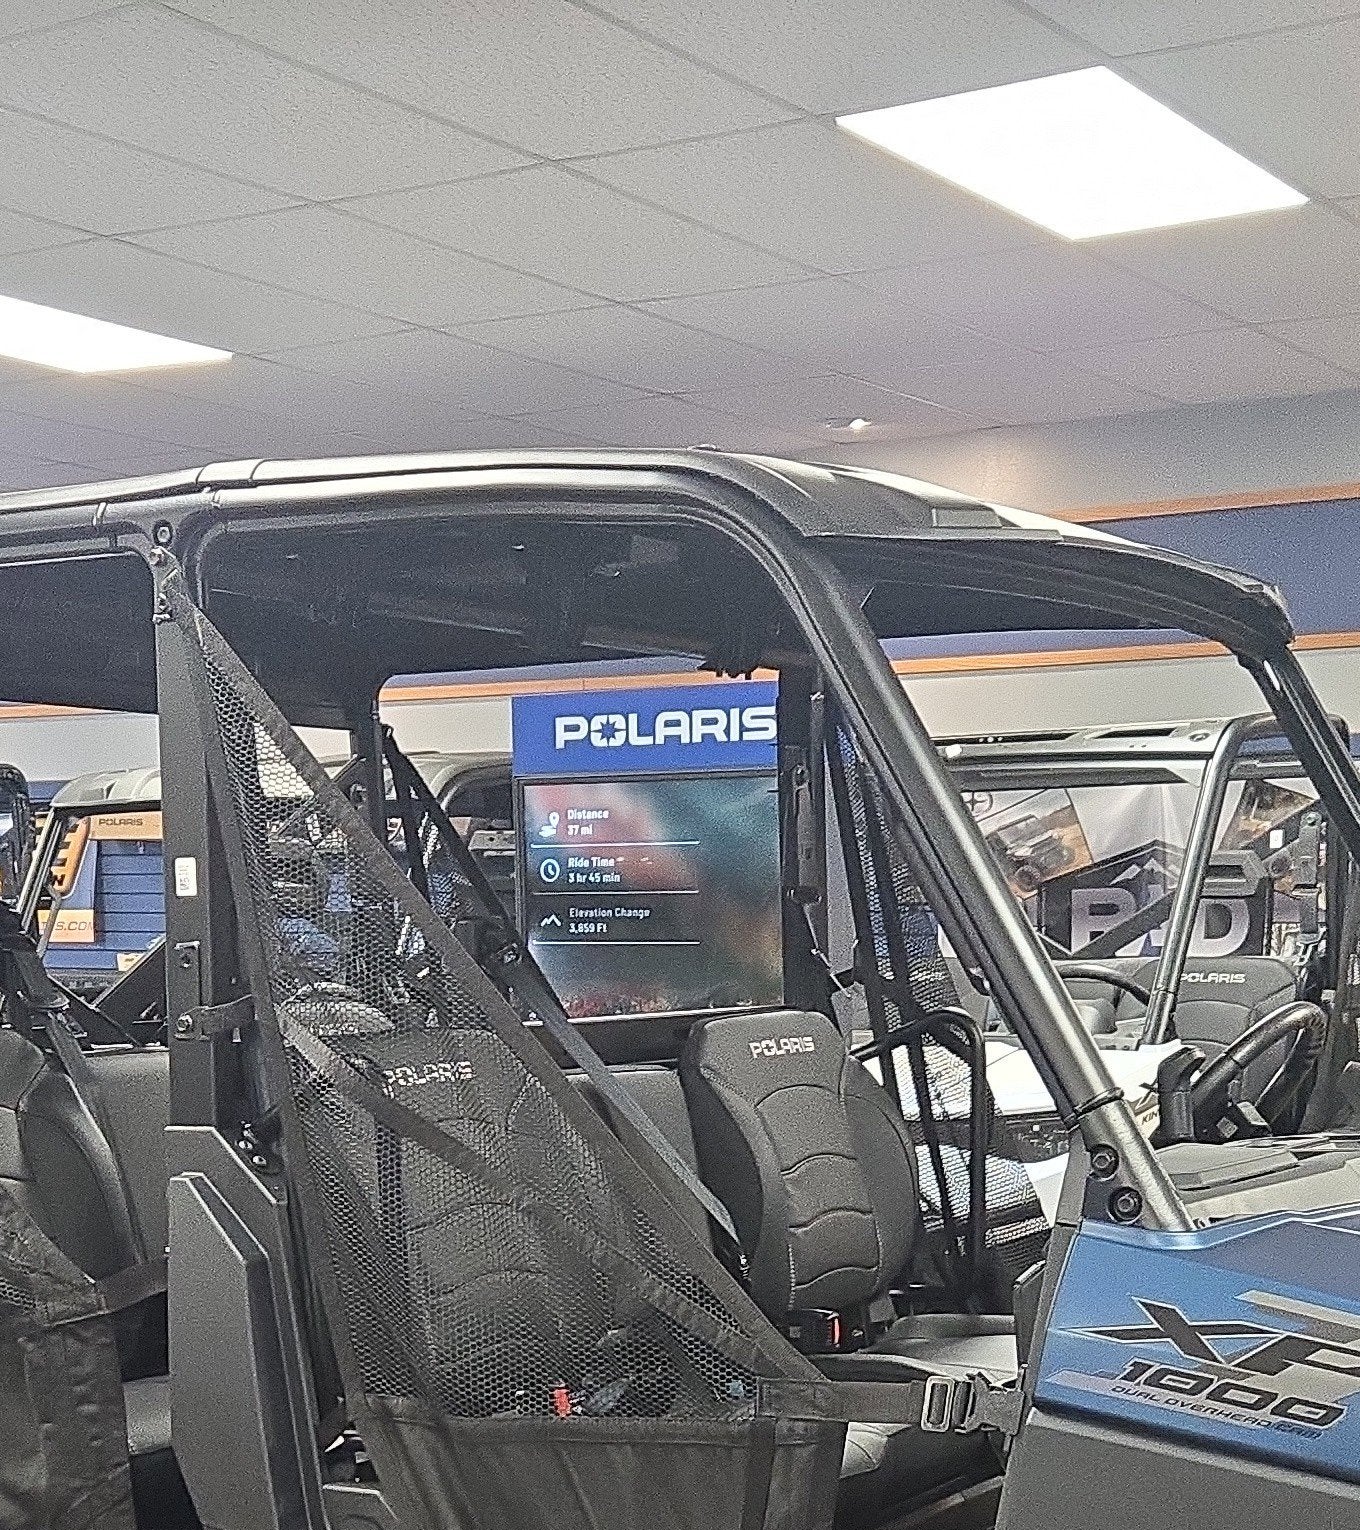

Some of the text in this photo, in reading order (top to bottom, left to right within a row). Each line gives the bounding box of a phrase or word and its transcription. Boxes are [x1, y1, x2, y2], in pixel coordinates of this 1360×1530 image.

[554, 706, 777, 750] POLARIS
[567, 809, 610, 820] Distance
[98, 818, 143, 826] POLARIS
[567, 824, 593, 836] 37 mi
[567, 856, 615, 868] Ride Time
[576, 873, 587, 883] hr
[588, 873, 601, 883] 45
[602, 872, 621, 883] min
[569, 908, 651, 920] Elevation Change
[596, 923, 608, 933] Ft
[748, 1036, 815, 1059] POLARIS
[1111, 1385, 1162, 1402] DUAL
[1116, 1356, 1347, 1429] 1000
